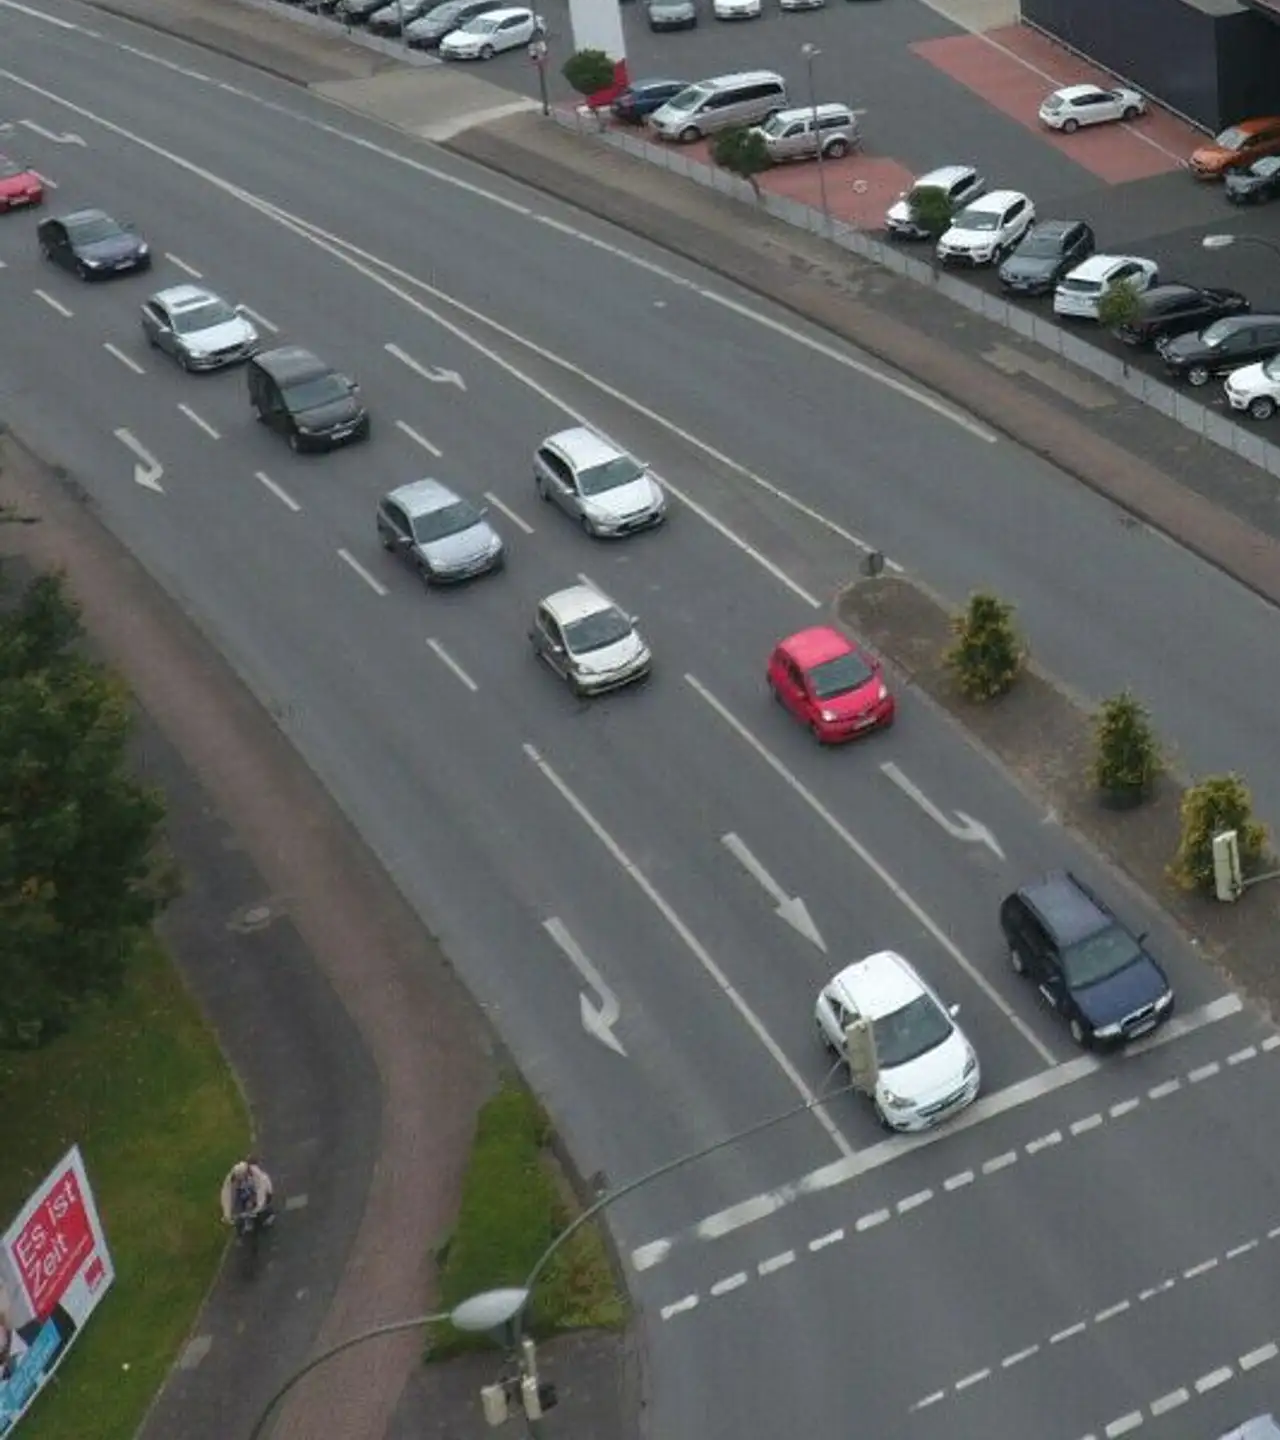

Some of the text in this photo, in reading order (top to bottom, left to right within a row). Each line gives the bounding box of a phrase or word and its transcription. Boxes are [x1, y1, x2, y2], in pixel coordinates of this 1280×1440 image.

[15, 1223, 47, 1279] Es
[44, 1178, 77, 1228] ist
[32, 1231, 69, 1299] Zeit
